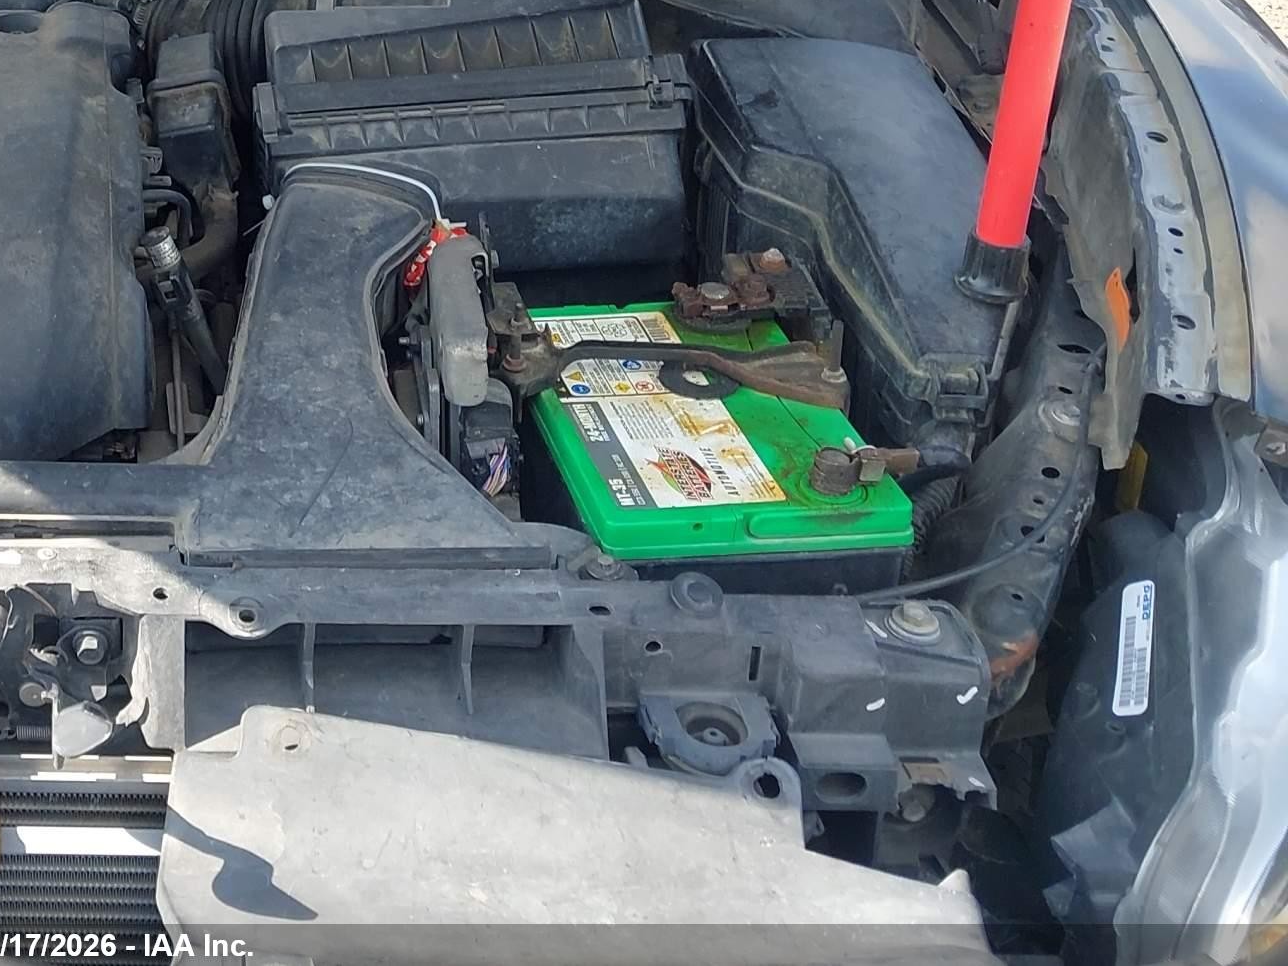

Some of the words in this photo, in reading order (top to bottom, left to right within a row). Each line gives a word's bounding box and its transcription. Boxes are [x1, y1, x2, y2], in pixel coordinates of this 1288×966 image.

[608, 478, 636, 506] MT-35
[658, 446, 699, 500] INTERSTATE
[673, 450, 711, 498] BATTERIES
[699, 446, 741, 496] AUTOMOTIVE
